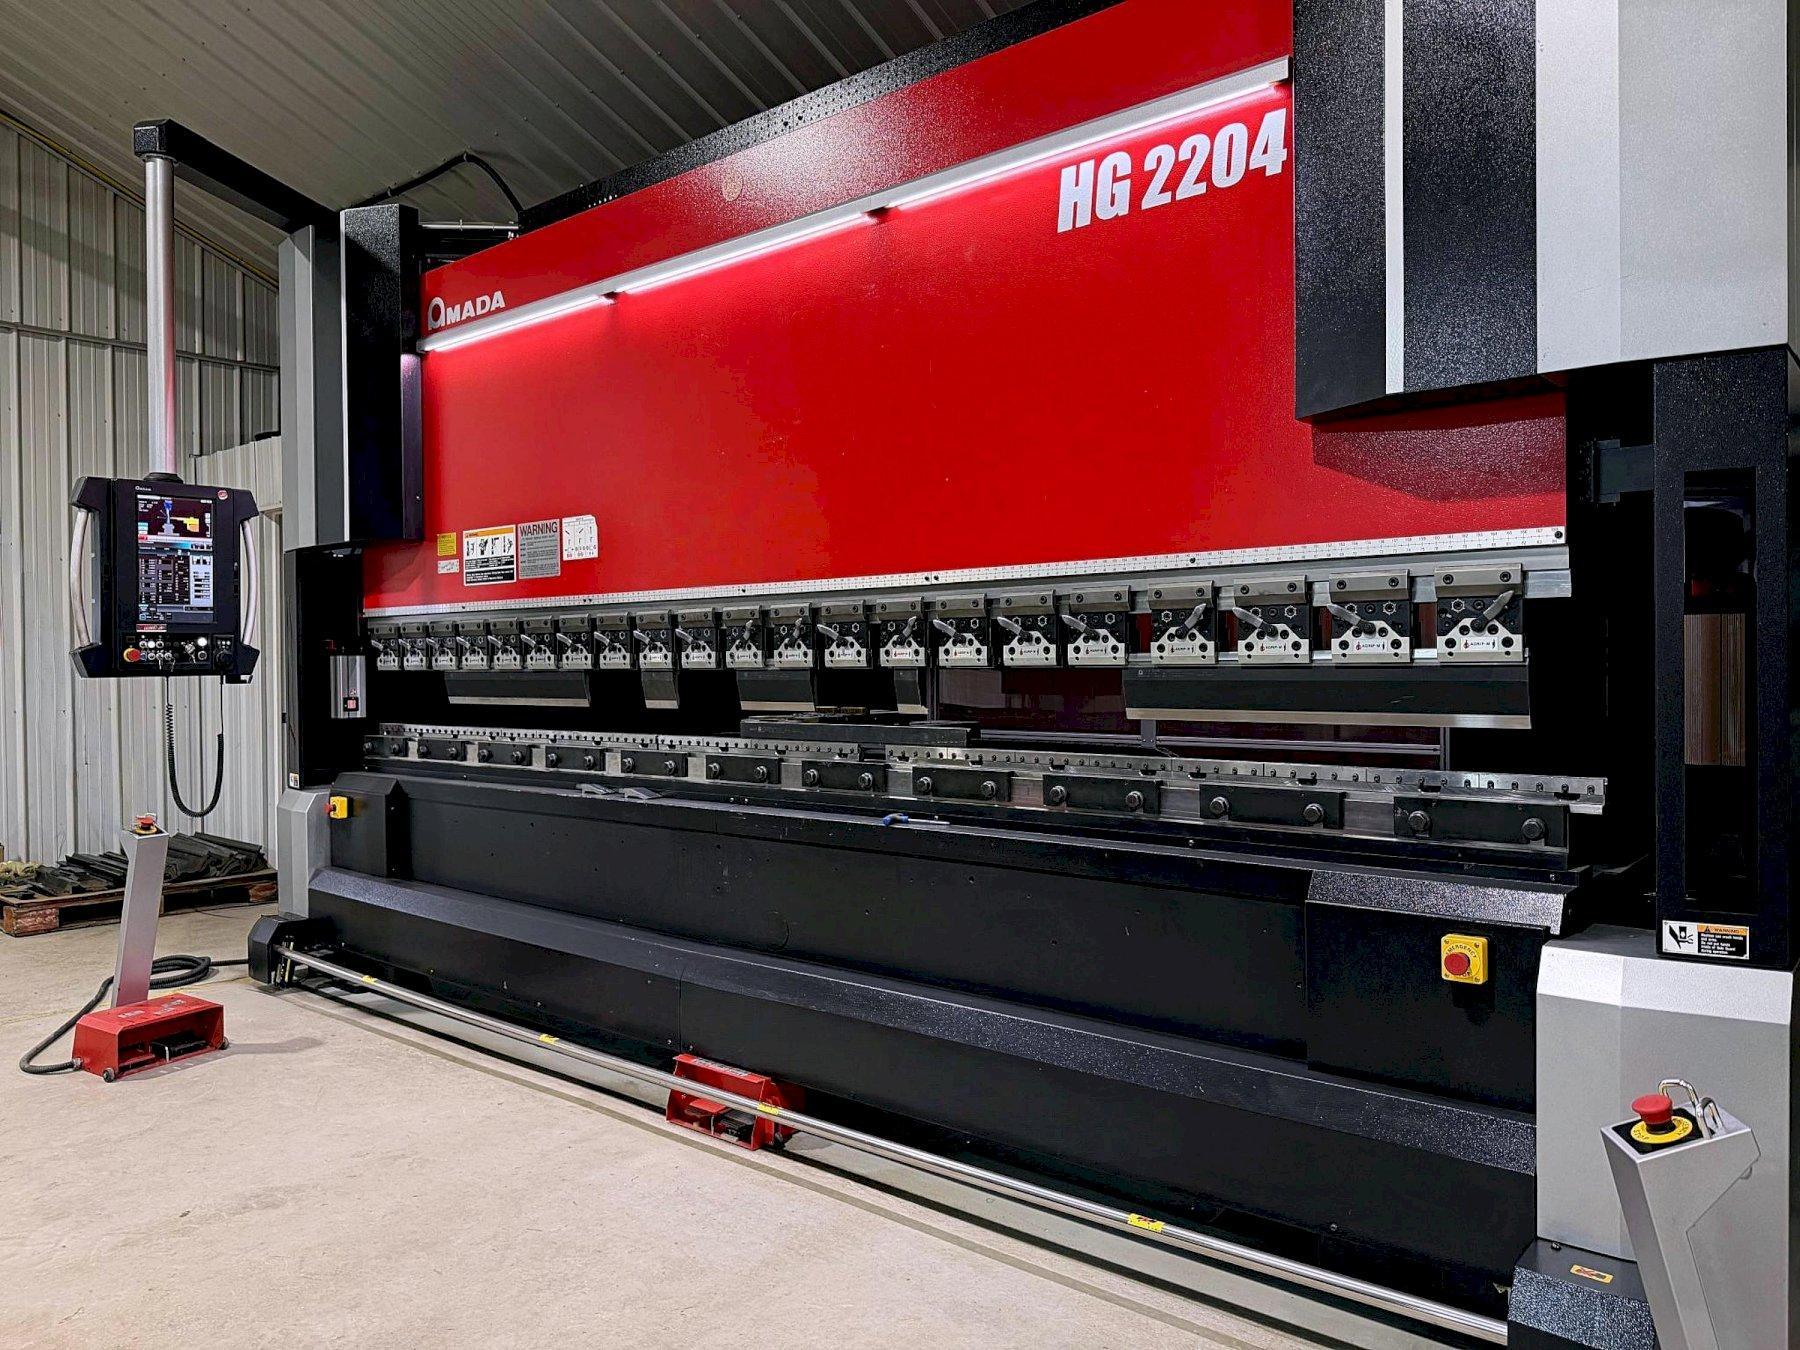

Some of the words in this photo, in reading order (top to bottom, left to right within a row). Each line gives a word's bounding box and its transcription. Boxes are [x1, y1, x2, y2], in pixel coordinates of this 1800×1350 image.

[1057, 151, 1132, 234] HG
[1141, 108, 1288, 210] 2204
[428, 290, 506, 331] AMADA
[519, 521, 558, 538] WARNING
